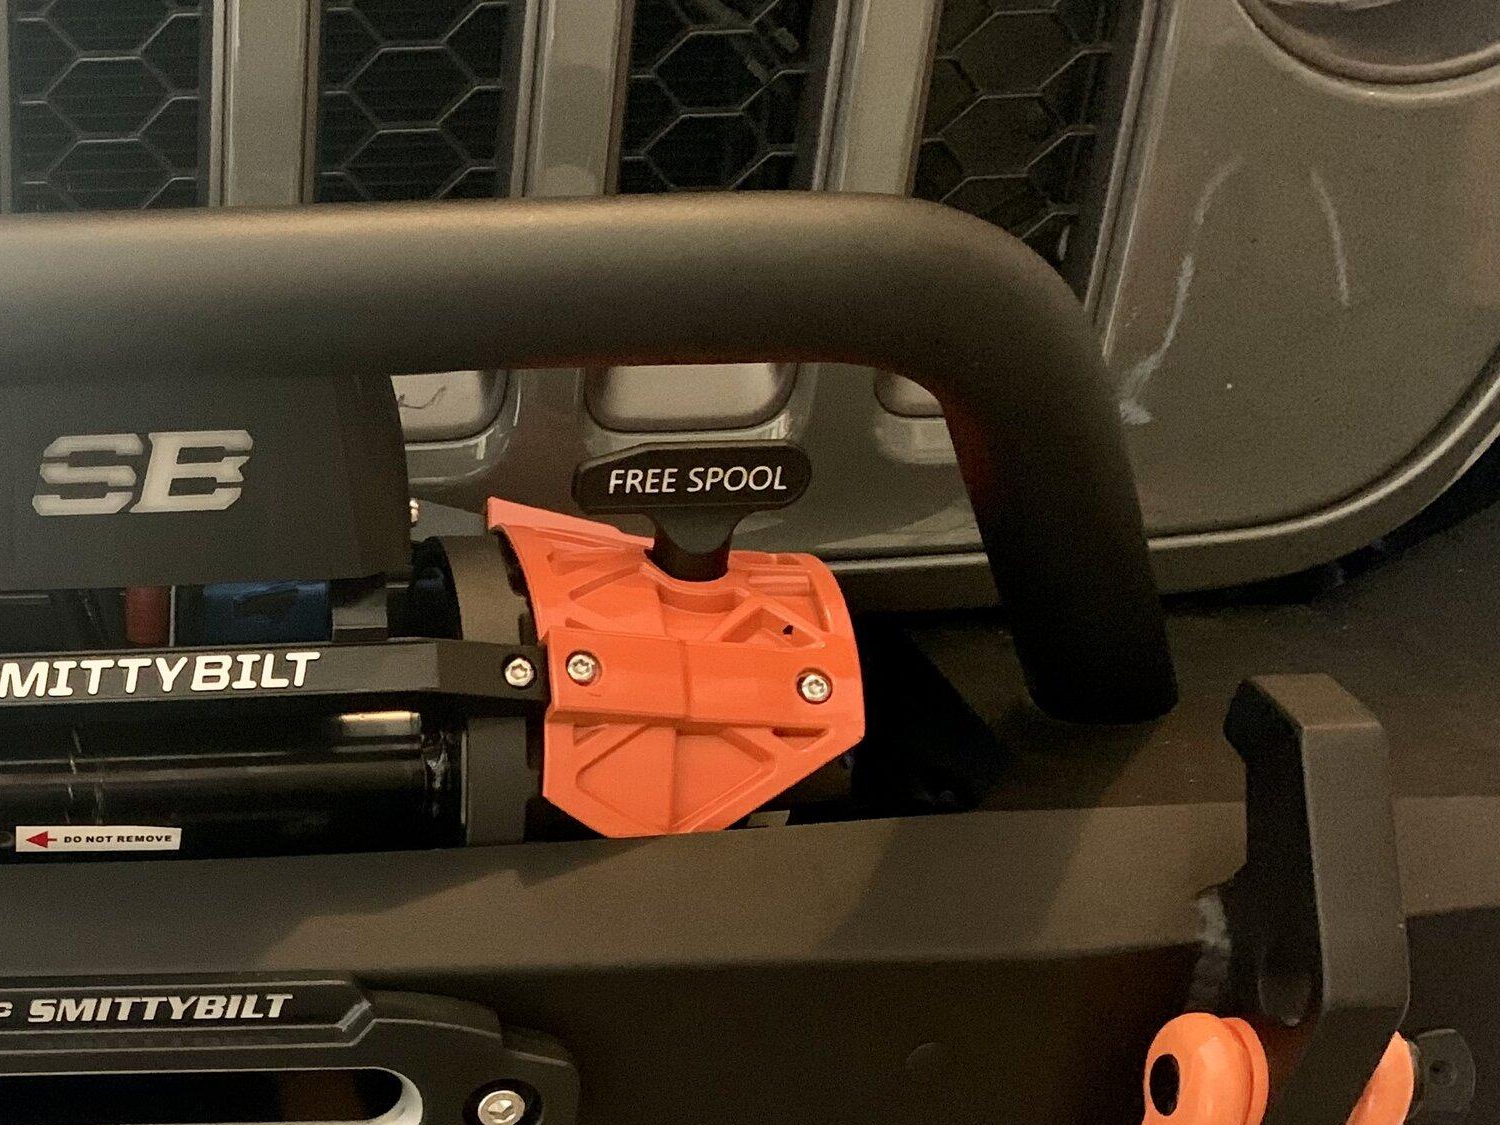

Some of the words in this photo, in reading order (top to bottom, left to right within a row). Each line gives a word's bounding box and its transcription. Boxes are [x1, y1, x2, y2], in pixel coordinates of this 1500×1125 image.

[608, 468, 679, 494] FREE
[687, 465, 787, 492] SPOOL
[63, 835, 82, 844] DO
[86, 835, 113, 843] NOT
[117, 834, 173, 843] REMOVE
[27, 993, 293, 1024] SMITTYBILT
